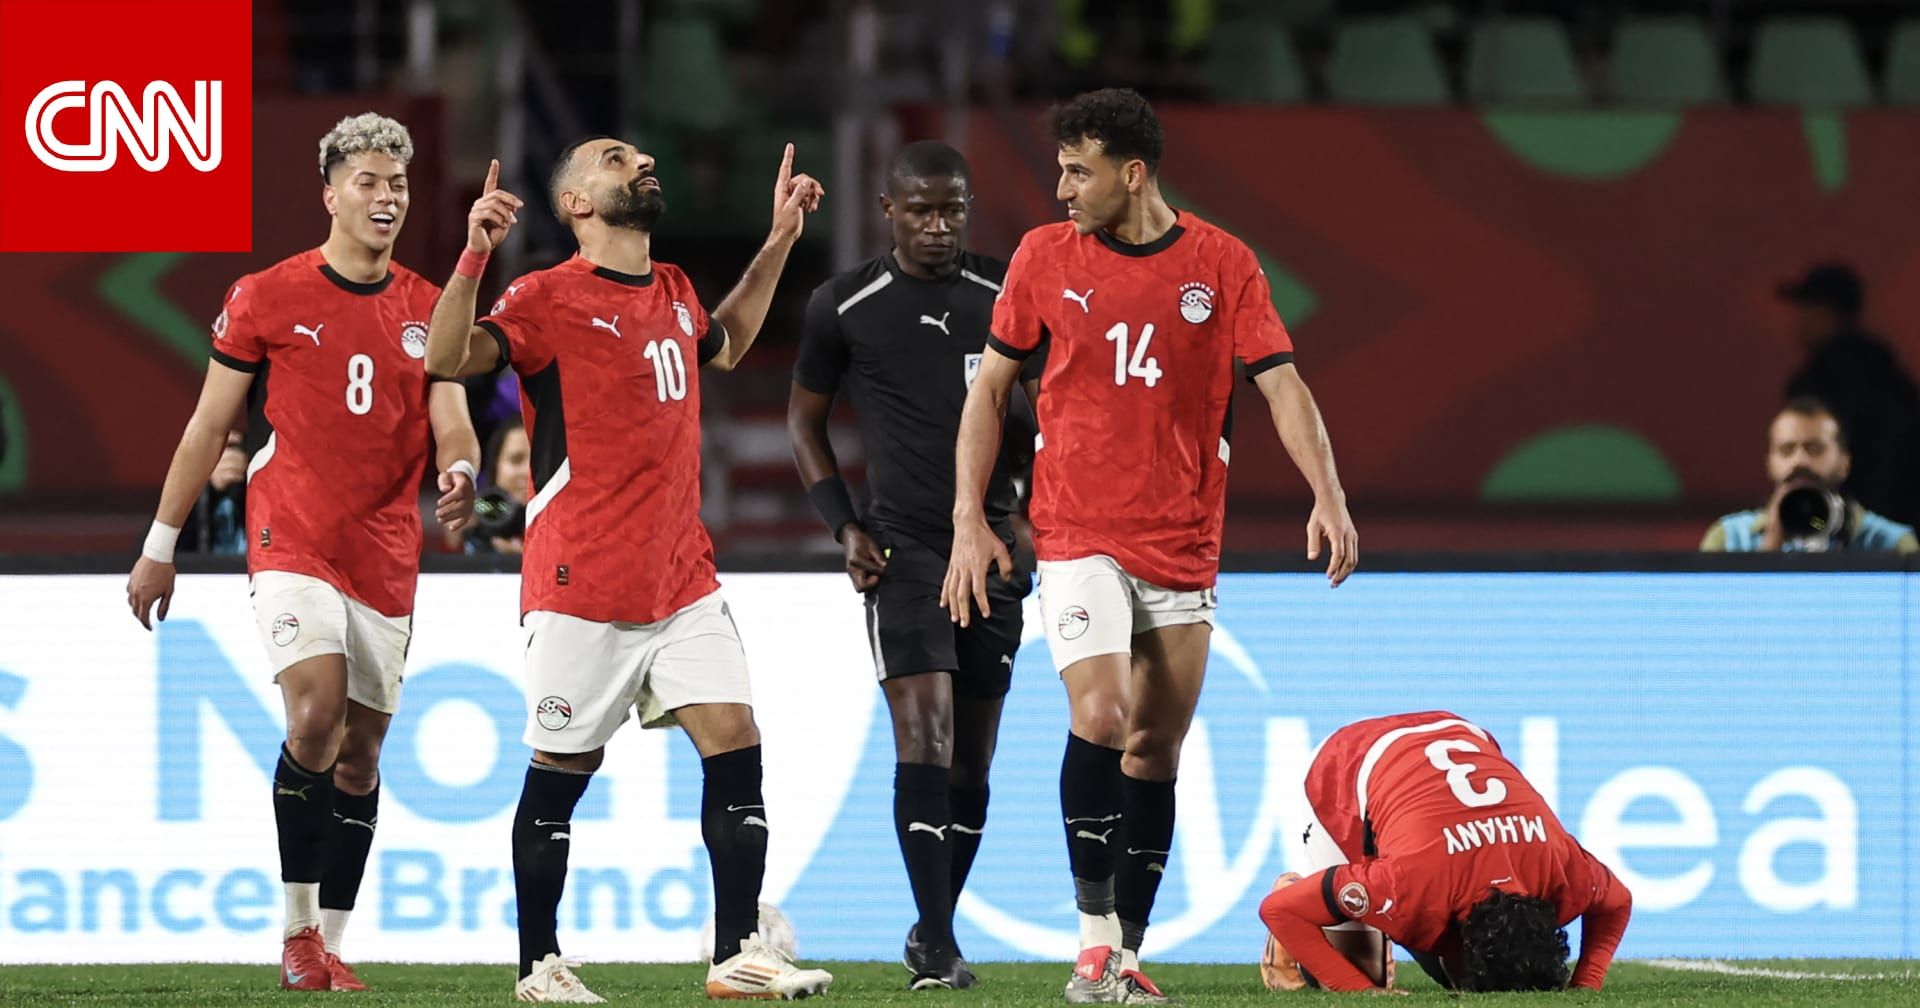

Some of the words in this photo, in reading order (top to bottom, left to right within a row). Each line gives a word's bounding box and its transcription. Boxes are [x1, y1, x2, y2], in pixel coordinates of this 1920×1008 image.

[346, 353, 374, 415] 8
[643, 338, 687, 403] 10
[1105, 322, 1163, 388] 14
[1424, 739, 1507, 808] 3
[1443, 815, 1547, 855] M.HANY
[0, 868, 277, 934] ance
[377, 844, 712, 934] Brnd
